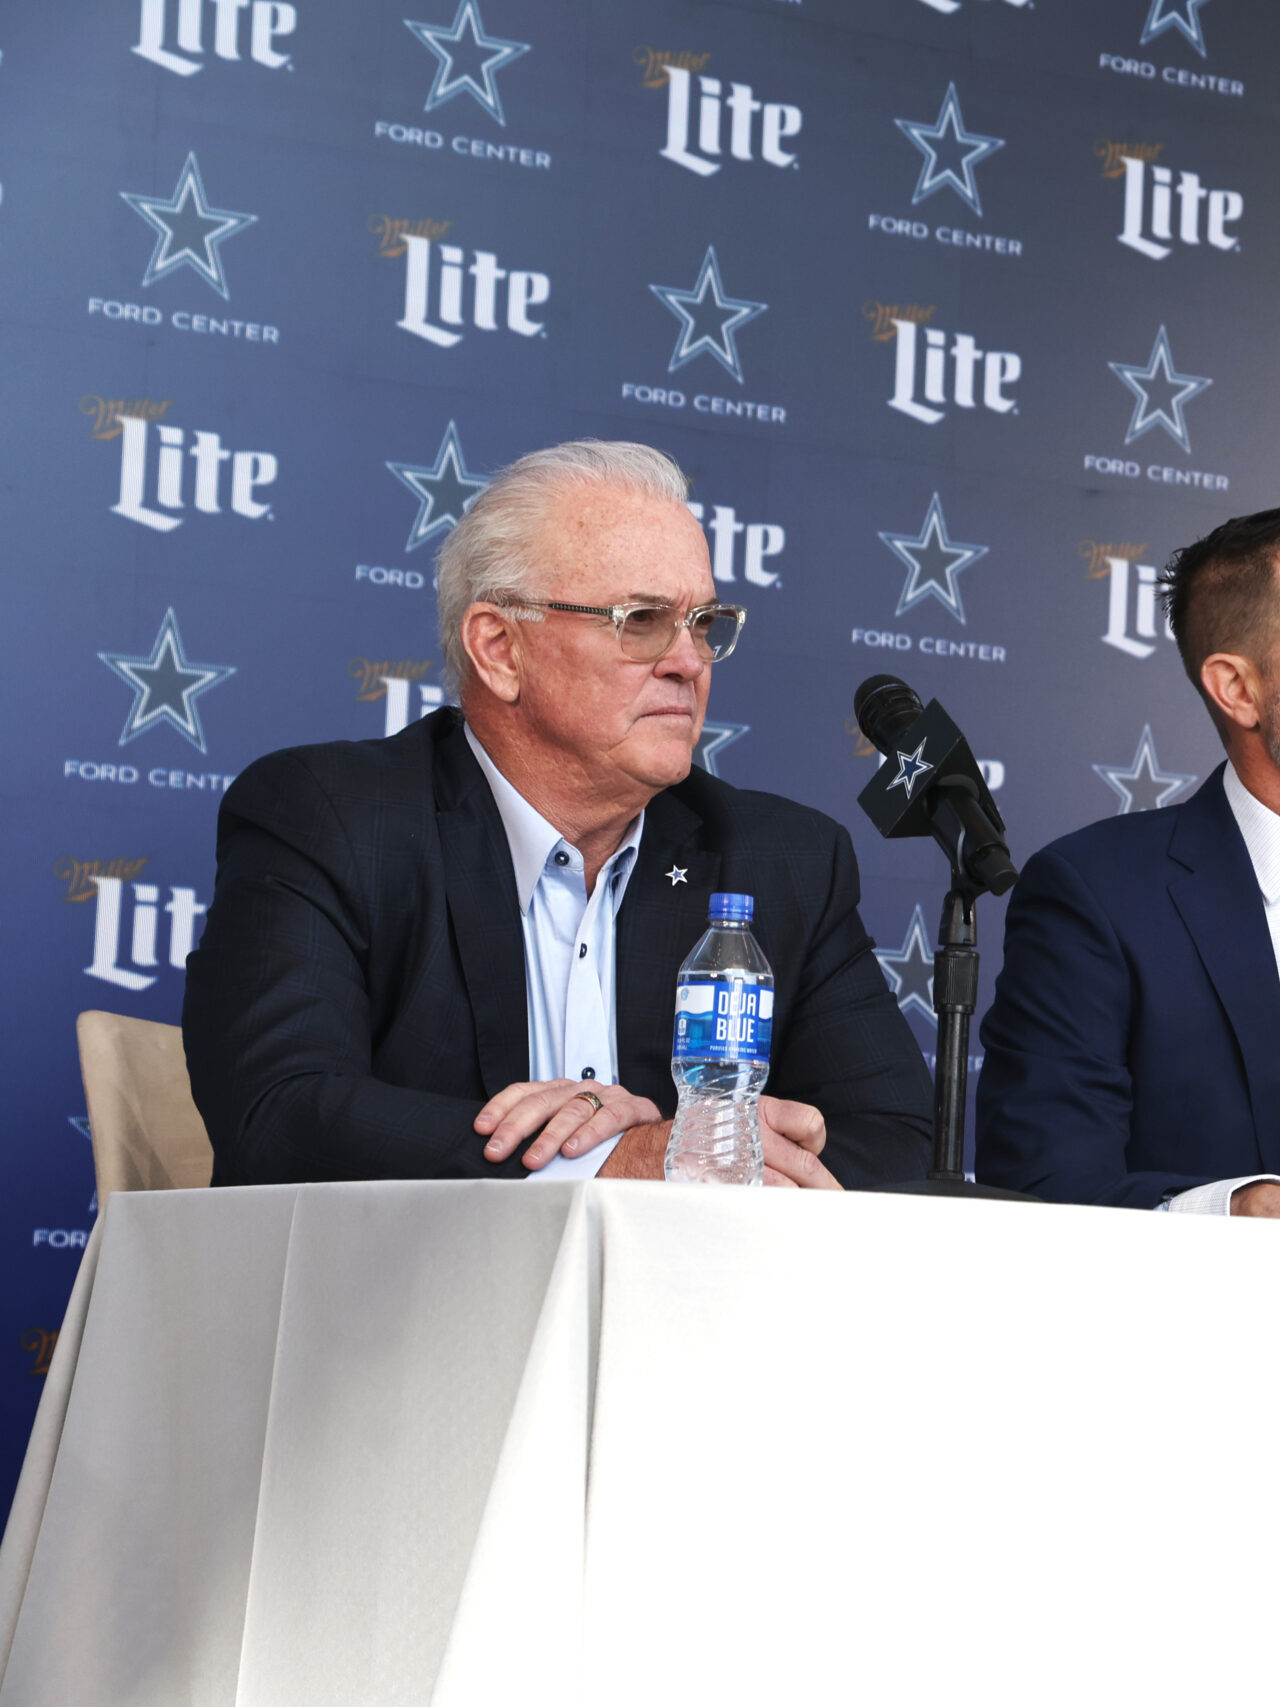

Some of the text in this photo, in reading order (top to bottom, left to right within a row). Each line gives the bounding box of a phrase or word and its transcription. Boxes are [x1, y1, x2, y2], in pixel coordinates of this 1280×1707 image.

[1100, 53, 1244, 96] FORD CENTER
[659, 64, 802, 177] Lite
[375, 120, 551, 169] FORD CENTER
[1117, 155, 1244, 260] Lite
[869, 213, 1022, 256] FORD CENTER
[397, 233, 550, 348] Lite
[88, 298, 279, 345] FORD CENTER
[887, 318, 1022, 425] Lite
[622, 381, 786, 423] FORD CENTER
[109, 415, 278, 532] Lite
[1084, 454, 1229, 491] FORD CENTER
[687, 501, 786, 588] te
[355, 565, 424, 590] FORD
[1101, 556, 1176, 658] Li
[852, 628, 1006, 663] FORD CENTER
[64, 759, 238, 792] FORD CENT
[83, 876, 206, 991] Lit
[718, 991, 757, 1016] DEJA
[716, 1017, 756, 1043] BLUE
[33, 1229, 87, 1248] FOR
